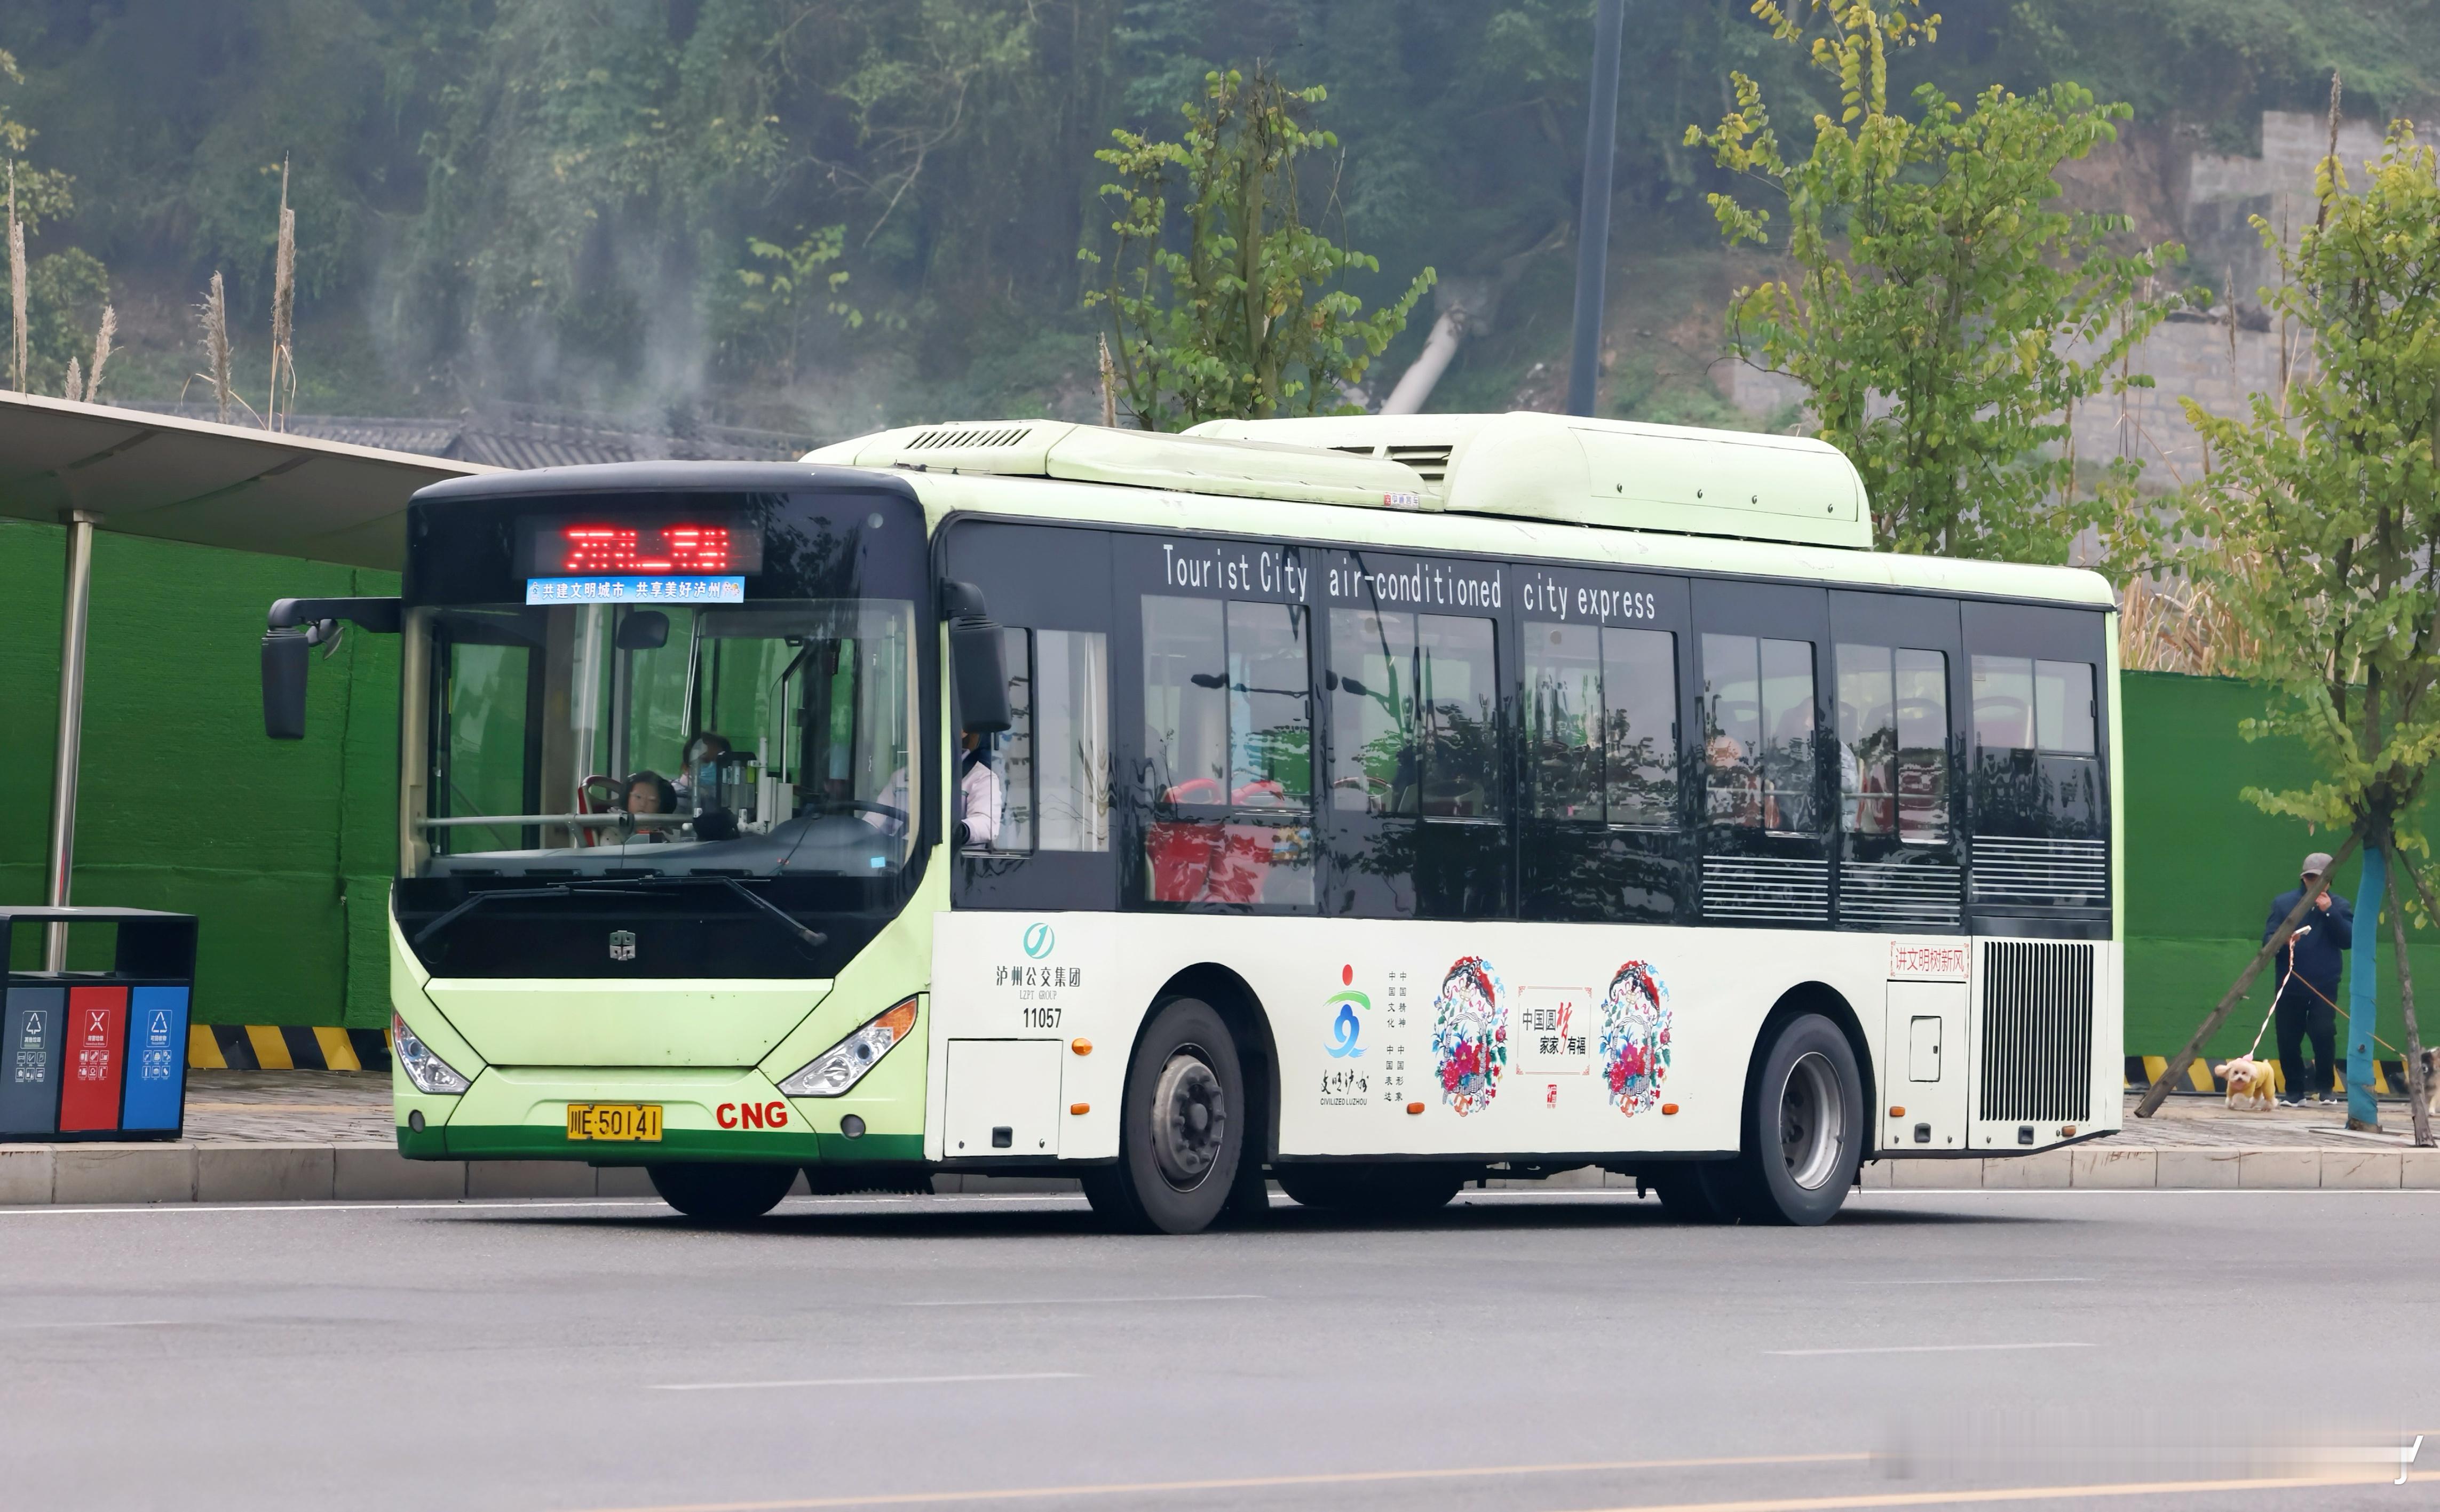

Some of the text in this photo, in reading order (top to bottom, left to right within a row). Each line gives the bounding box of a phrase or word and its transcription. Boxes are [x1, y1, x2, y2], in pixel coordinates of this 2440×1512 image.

[542, 582, 720, 599] 共建文明城市 共享美好泸州
[1163, 544, 1654, 623] Tourist City air-conditioned city express
[1896, 948, 1964, 972] 讲文明树新风
[996, 966, 1081, 987] 泸州公交集团
[1019, 990, 1057, 1000] LZPT GROUP
[1387, 971, 1396, 1028] 中国文化
[1398, 971, 1407, 1028] 中国精神
[1023, 1008, 1061, 1028] 11057
[1384, 1045, 1394, 1102] 中国表达
[1395, 1045, 1405, 1102] 中国形象
[716, 1102, 788, 1129] CNG
